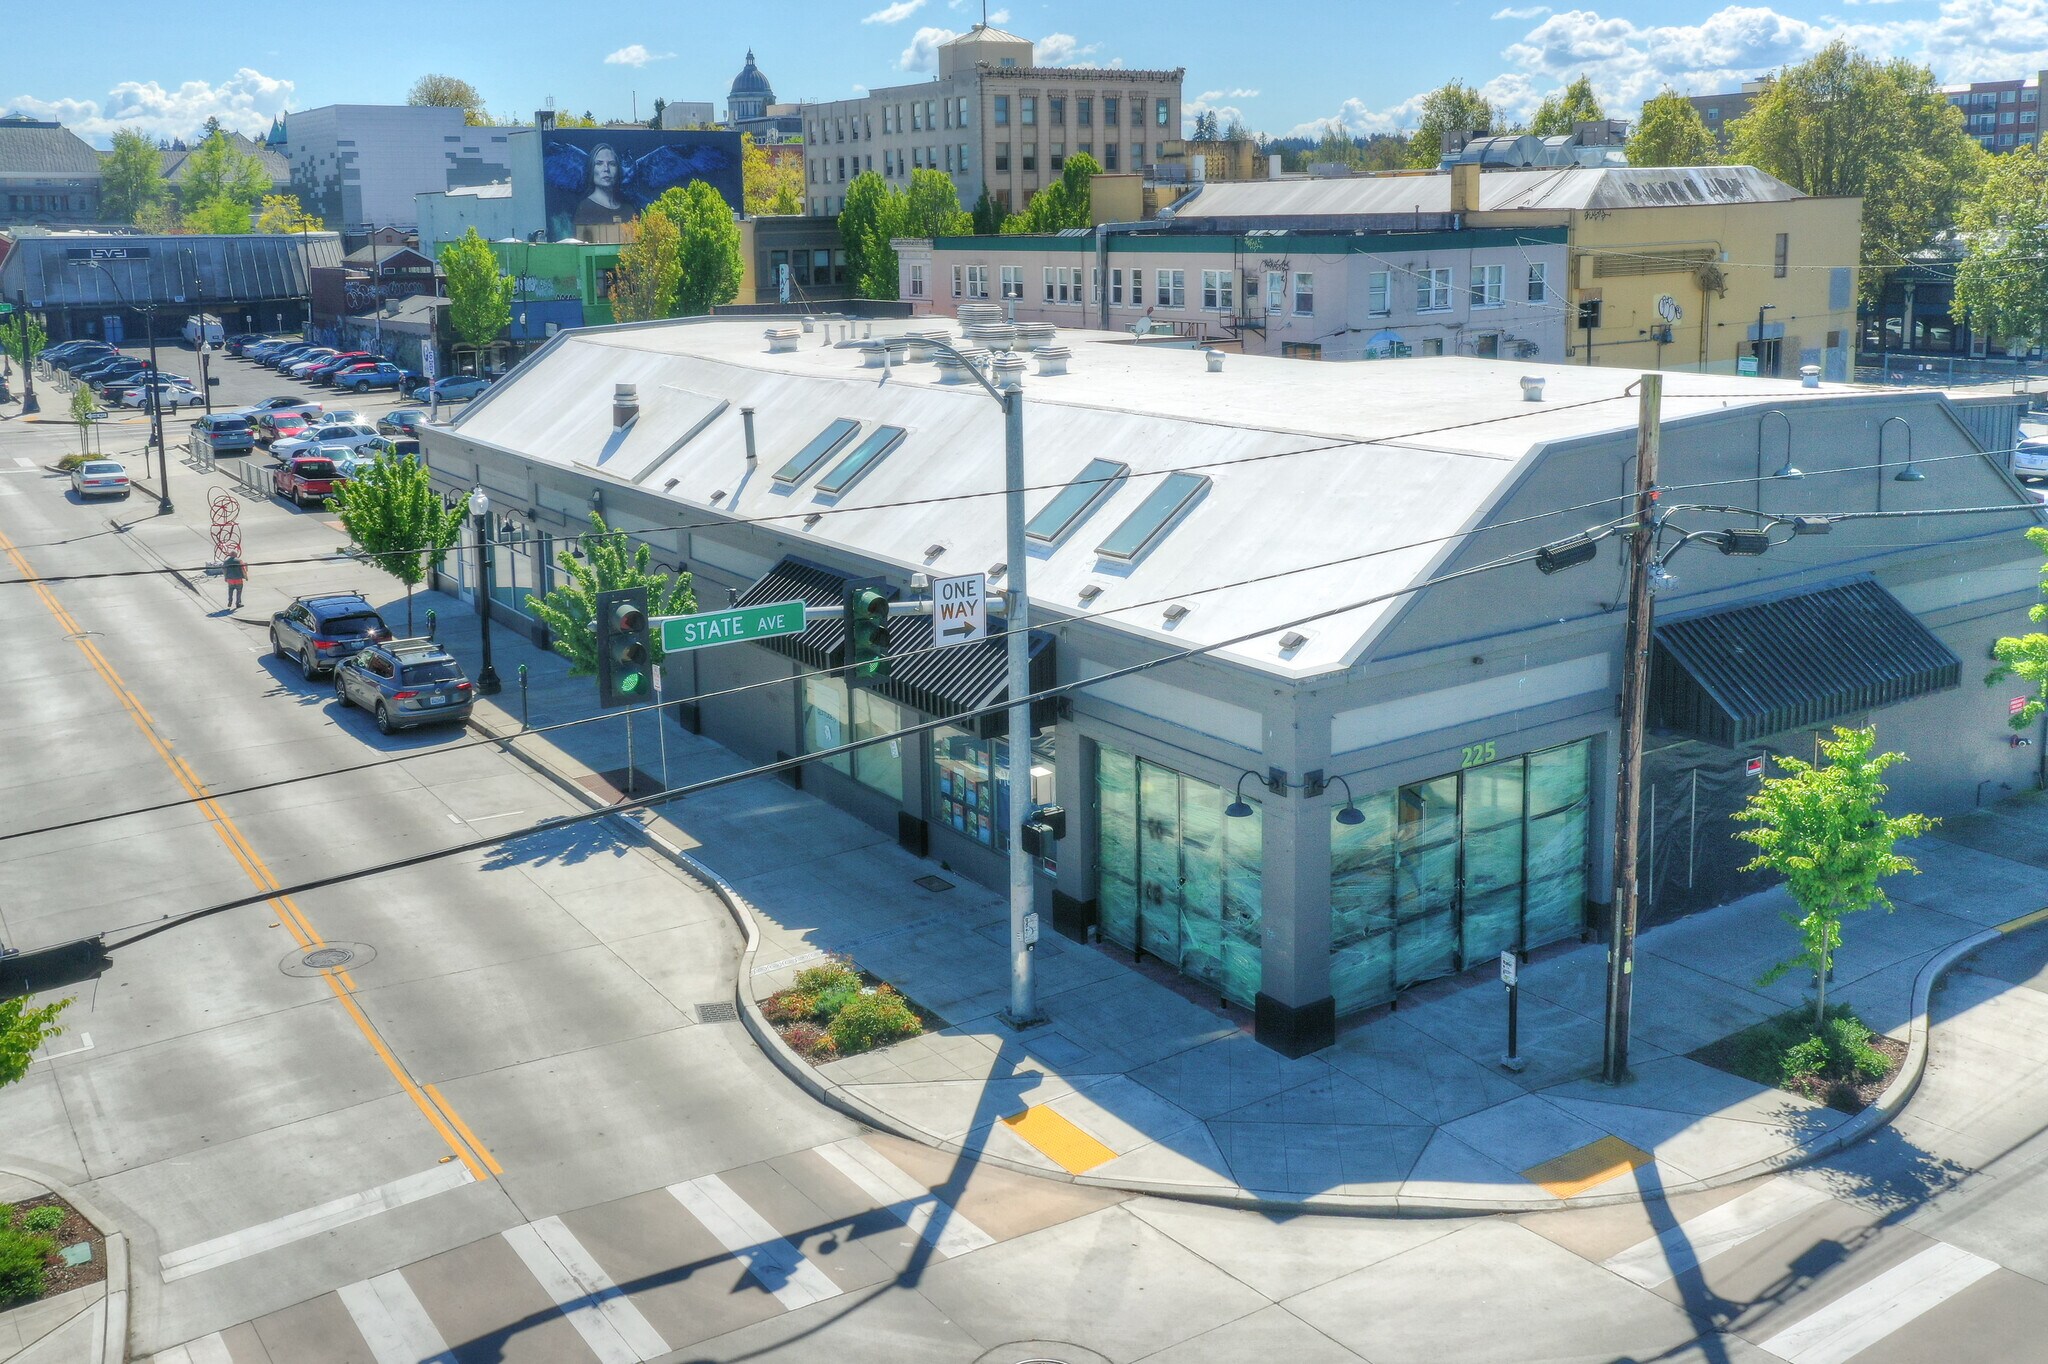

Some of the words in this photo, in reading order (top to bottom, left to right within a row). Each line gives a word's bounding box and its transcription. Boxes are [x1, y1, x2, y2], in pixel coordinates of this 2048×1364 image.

[90, 249, 127, 259] LEVEL
[942, 579, 977, 600] ONE
[940, 598, 979, 621] WAY
[684, 616, 744, 642] STATE
[757, 614, 786, 632] AVE
[1461, 741, 1496, 769] 225
